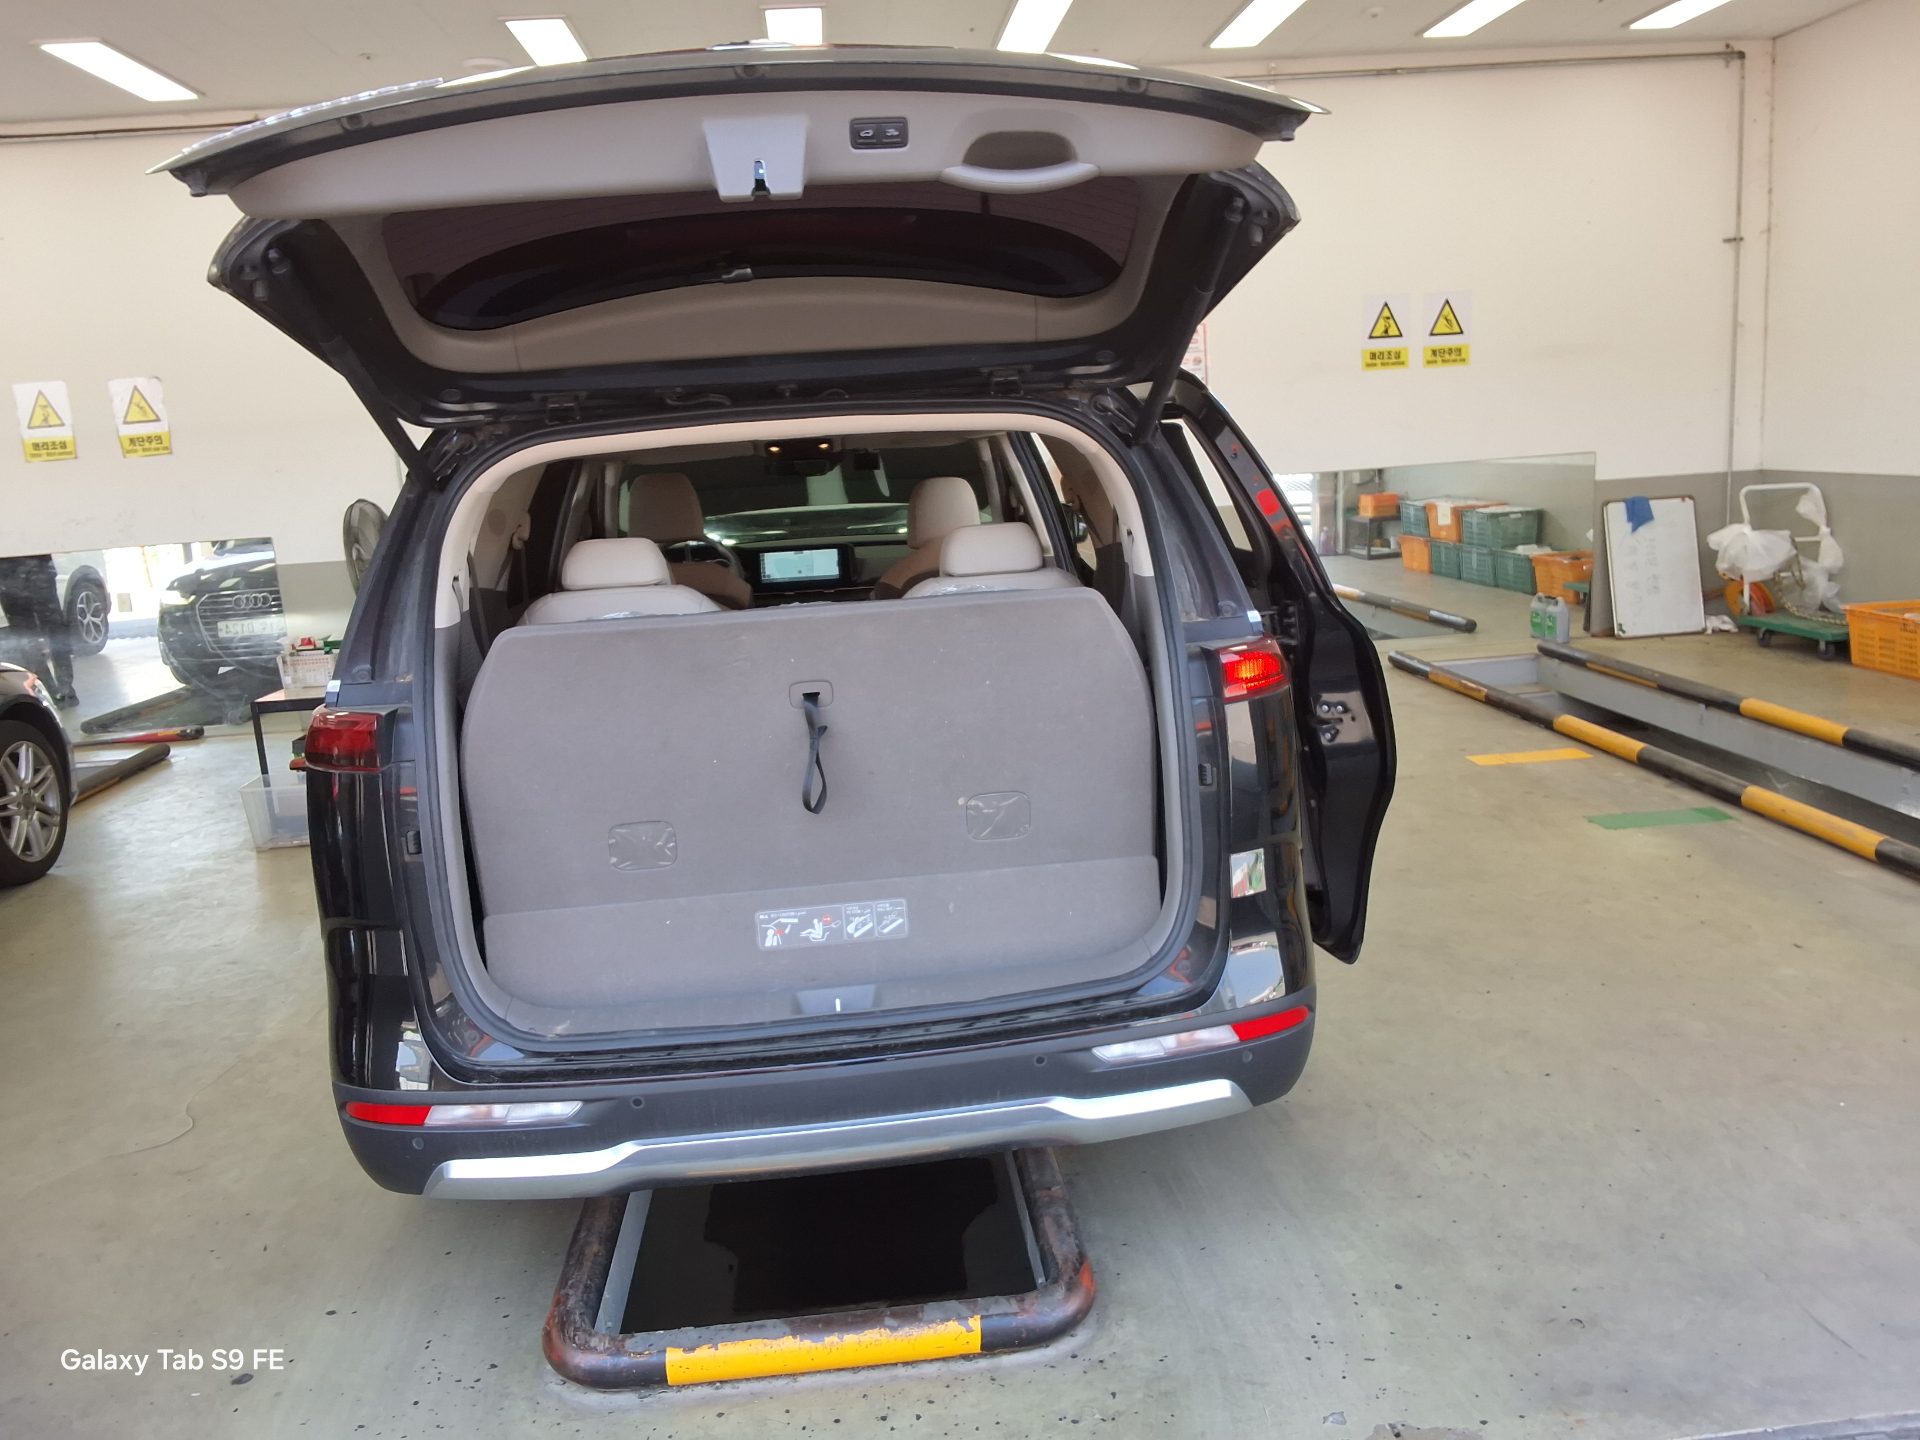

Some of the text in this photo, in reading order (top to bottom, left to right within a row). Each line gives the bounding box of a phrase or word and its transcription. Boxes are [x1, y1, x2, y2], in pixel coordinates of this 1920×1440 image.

[1369, 350, 1402, 360] 머리조심
[1430, 347, 1462, 357] 계단주의
[127, 436, 163, 447] 계단주의
